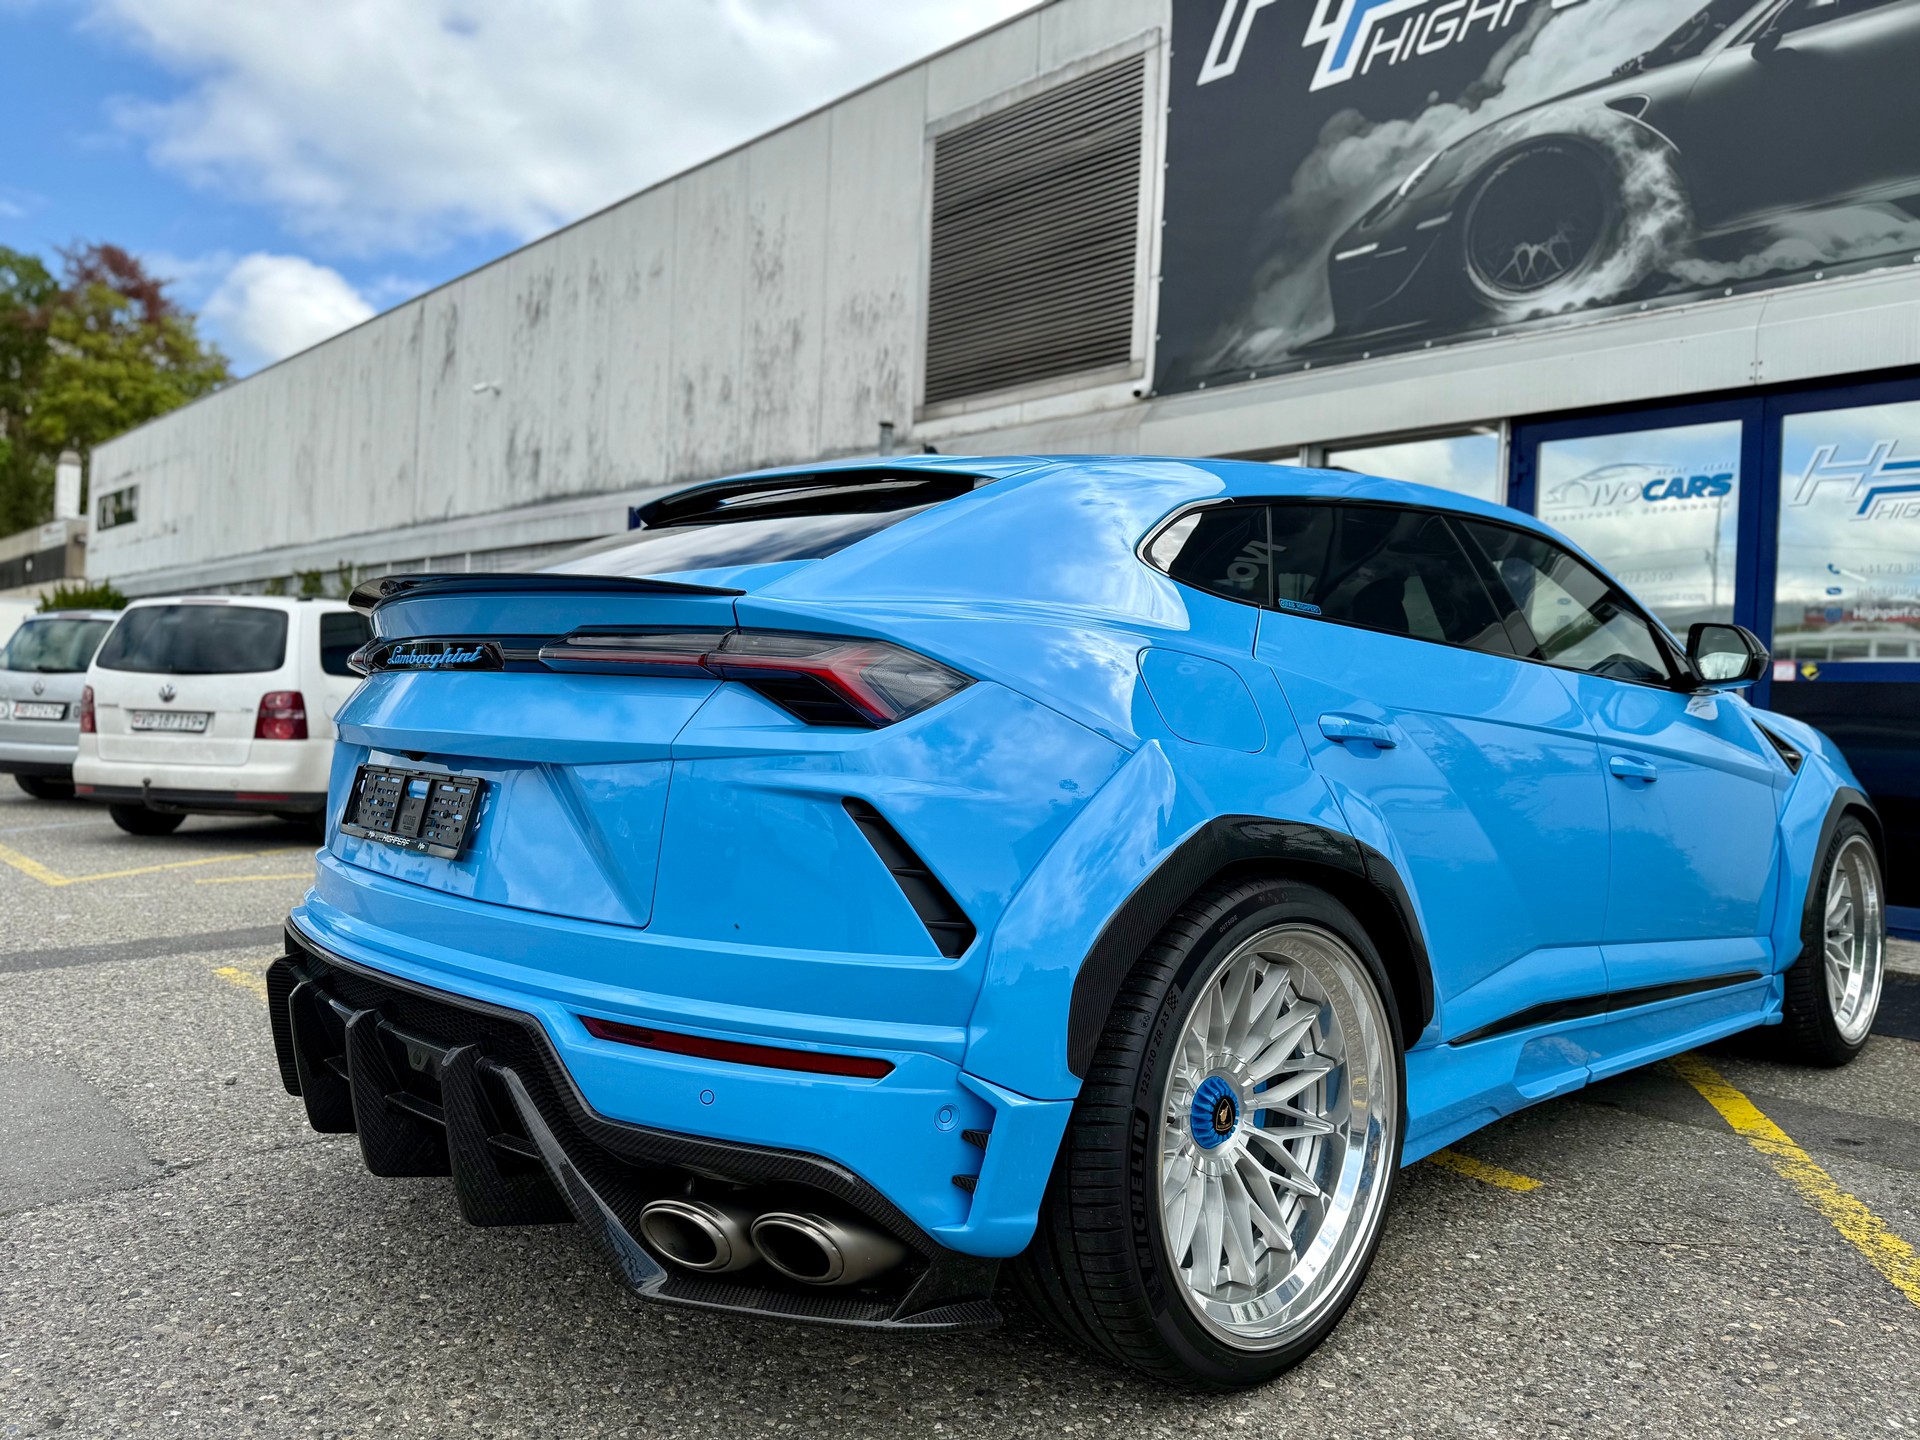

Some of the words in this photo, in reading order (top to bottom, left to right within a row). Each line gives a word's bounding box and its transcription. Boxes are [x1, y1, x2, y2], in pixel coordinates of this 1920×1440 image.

[387, 645, 484, 669] Lamborghini
[1140, 1048, 1157, 1096] 325/30
[1153, 1029, 1164, 1048] ZR
[1160, 1012, 1171, 1028] 23
[1130, 1116, 1154, 1270] MICHELIN
